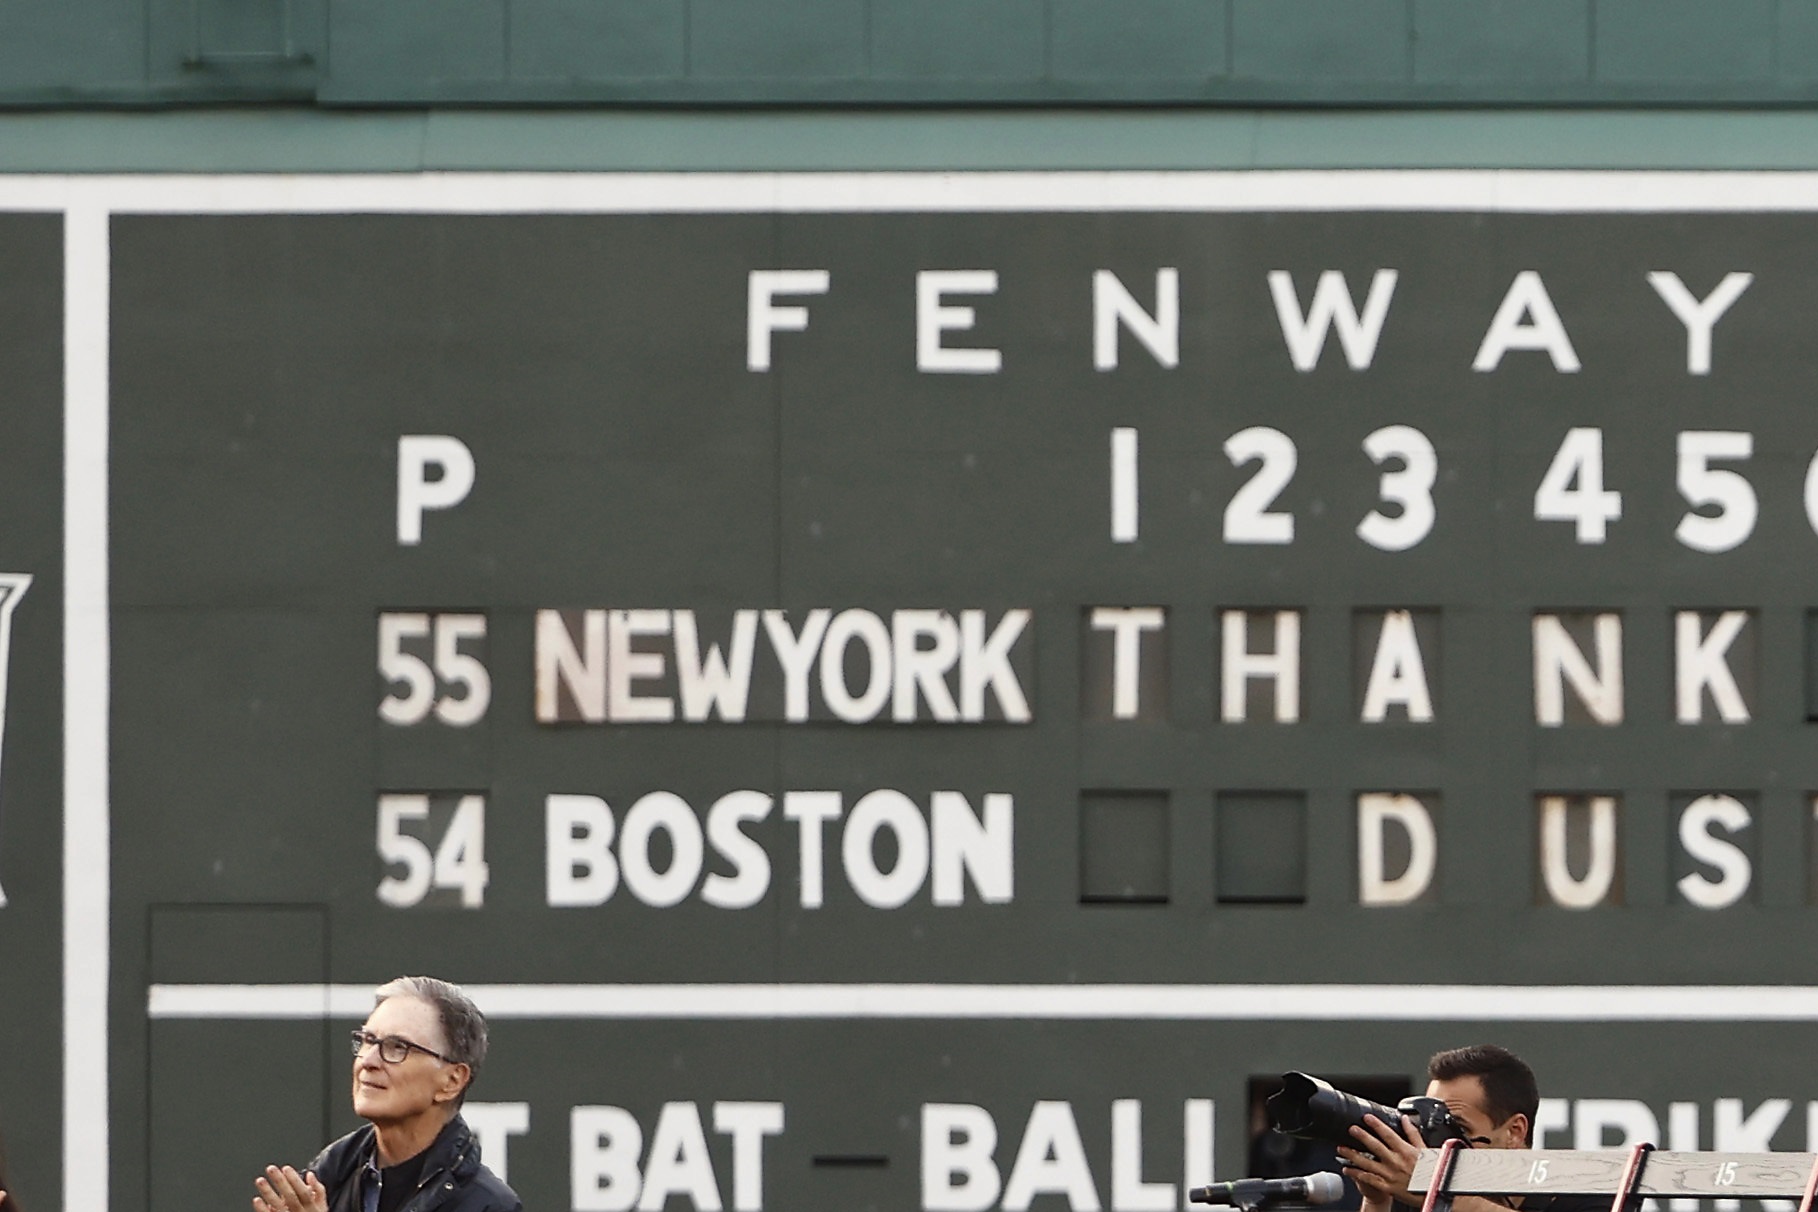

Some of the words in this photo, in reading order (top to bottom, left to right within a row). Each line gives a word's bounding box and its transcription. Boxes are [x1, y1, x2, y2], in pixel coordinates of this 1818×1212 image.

[748, 268, 1752, 374] FENWAY
[398, 436, 474, 543] P
[1112, 428, 1138, 541] 1
[1224, 427, 1296, 543] 2
[1358, 426, 1437, 550] 3
[1535, 428, 1621, 543] 4
[1677, 431, 1757, 551] 5
[379, 614, 490, 726] 55
[1092, 610, 1750, 726] THANK
[378, 796, 488, 907] 54
[546, 790, 1013, 907] BOSTON
[1528, 1160, 1548, 1183] 15
[1715, 1162, 1737, 1185] 15
